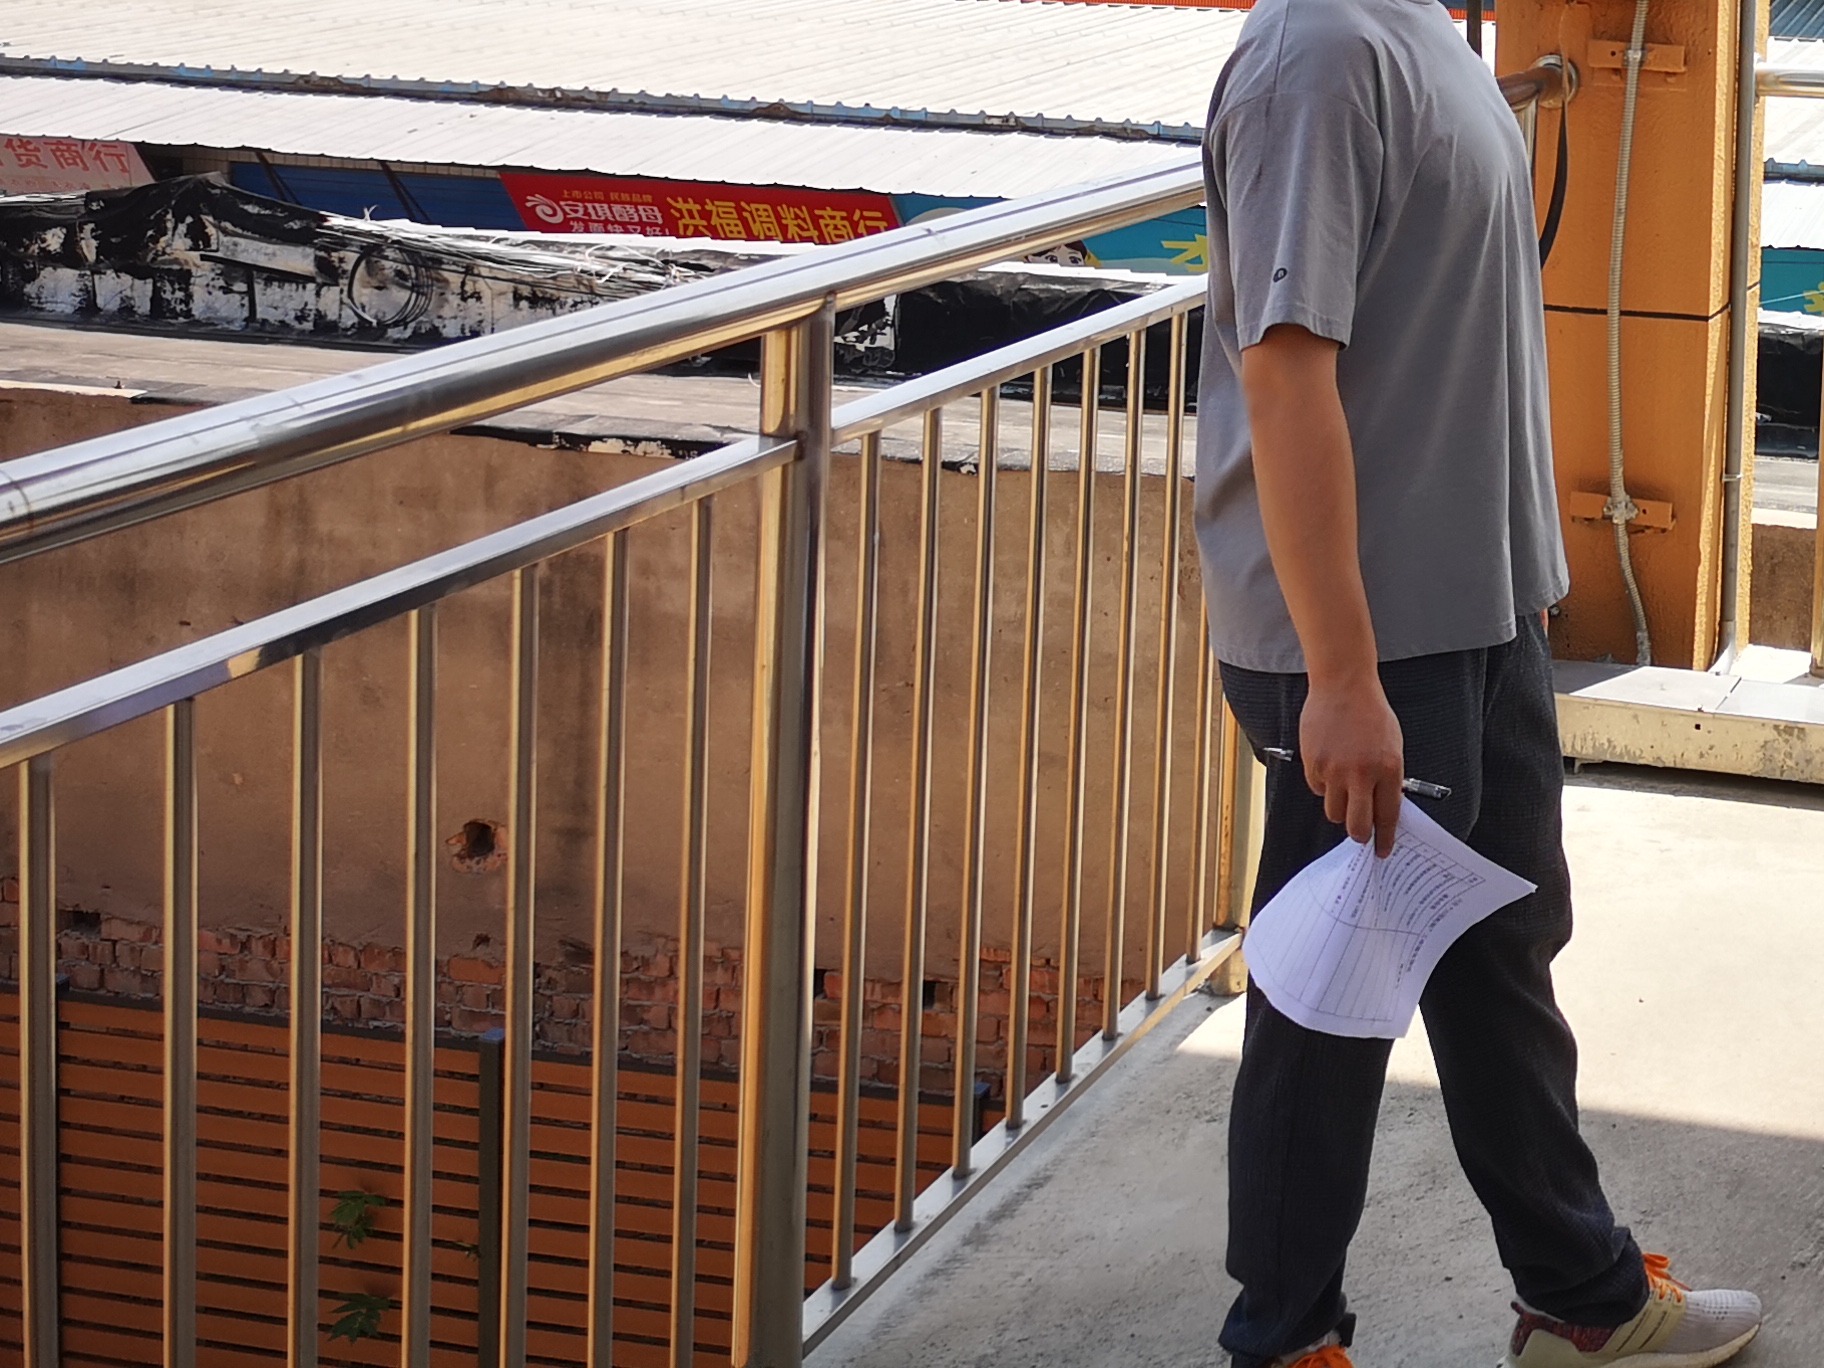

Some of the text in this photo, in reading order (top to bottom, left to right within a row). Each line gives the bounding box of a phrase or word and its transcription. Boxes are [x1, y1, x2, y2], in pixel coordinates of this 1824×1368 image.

[0, 137, 130, 174] 货商行
[562, 189, 605, 201] 上市公司
[559, 200, 664, 225] 安琪酵母
[666, 196, 889, 244] 洪福调料商行
